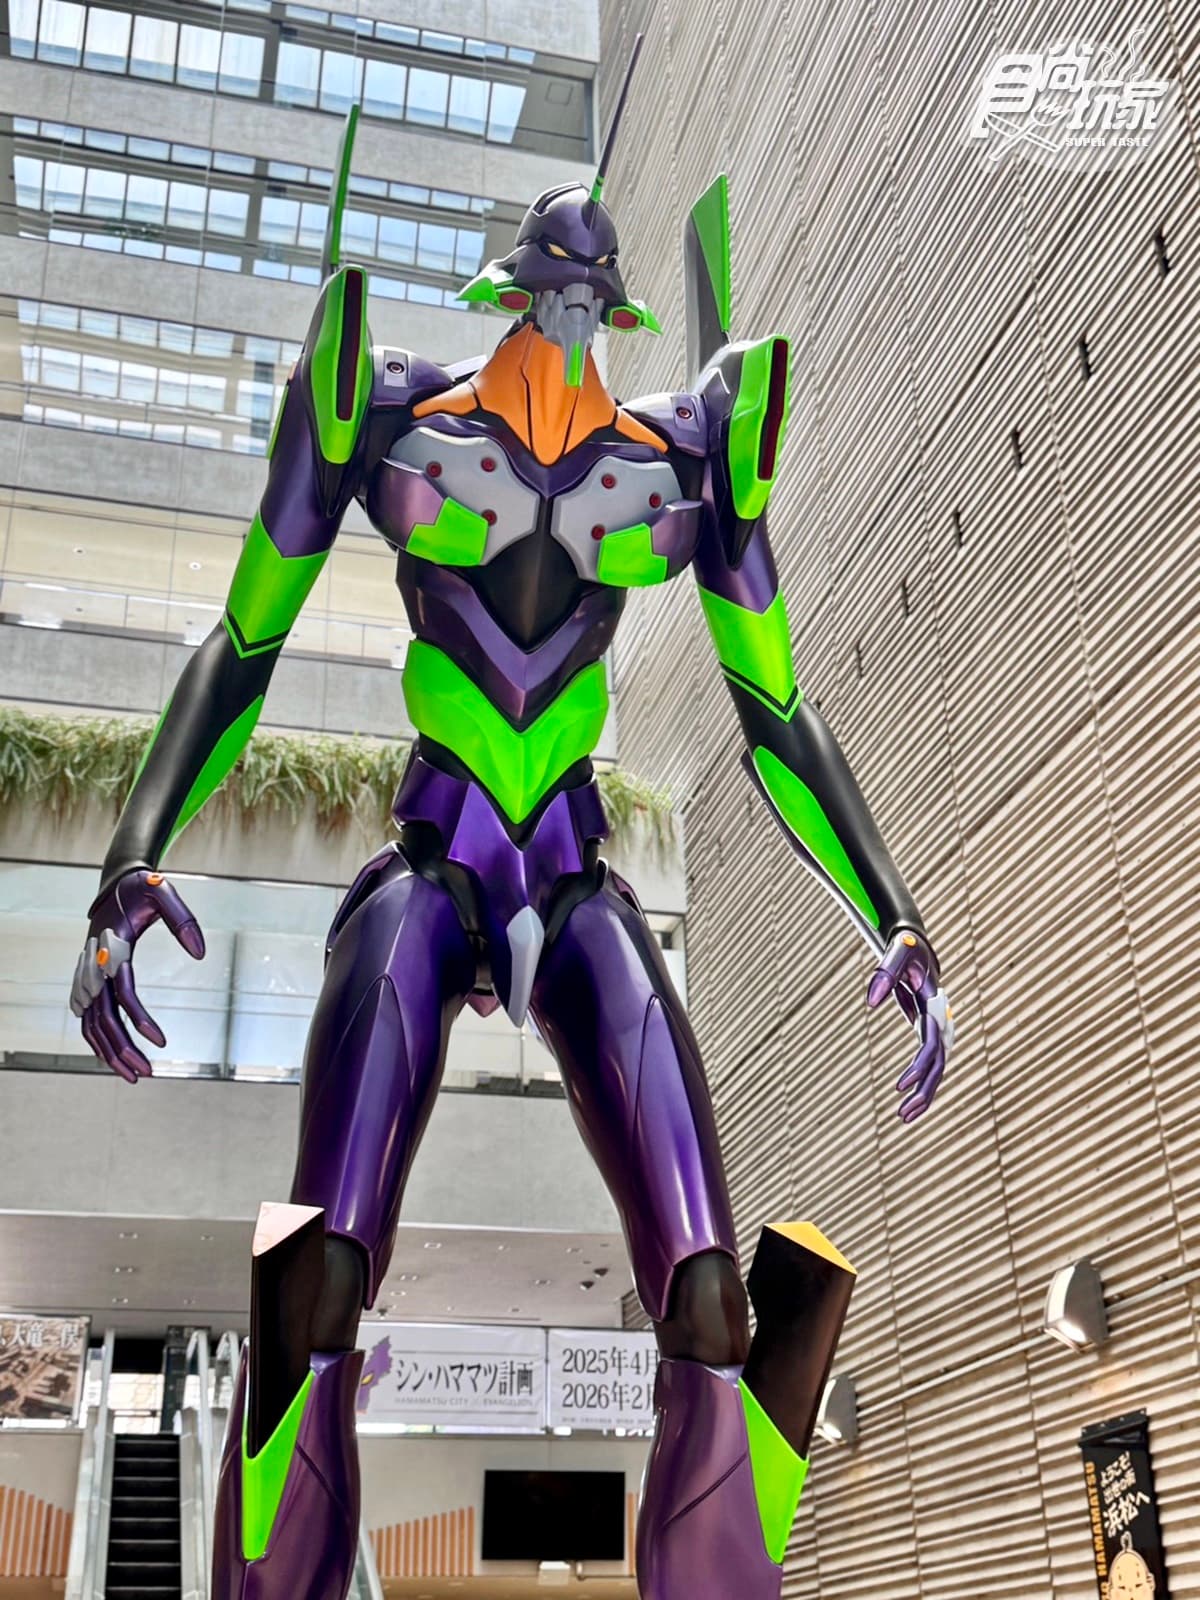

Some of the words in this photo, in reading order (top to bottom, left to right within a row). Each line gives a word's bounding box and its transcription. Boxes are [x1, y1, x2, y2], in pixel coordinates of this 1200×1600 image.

[396, 1359, 534, 1397] シン・ハママツ計画
[561, 1346, 659, 1377] 2025年4月
[1085, 1461, 1108, 1576] HAMAMATSU
[1103, 1491, 1150, 1538] 浜松へ
